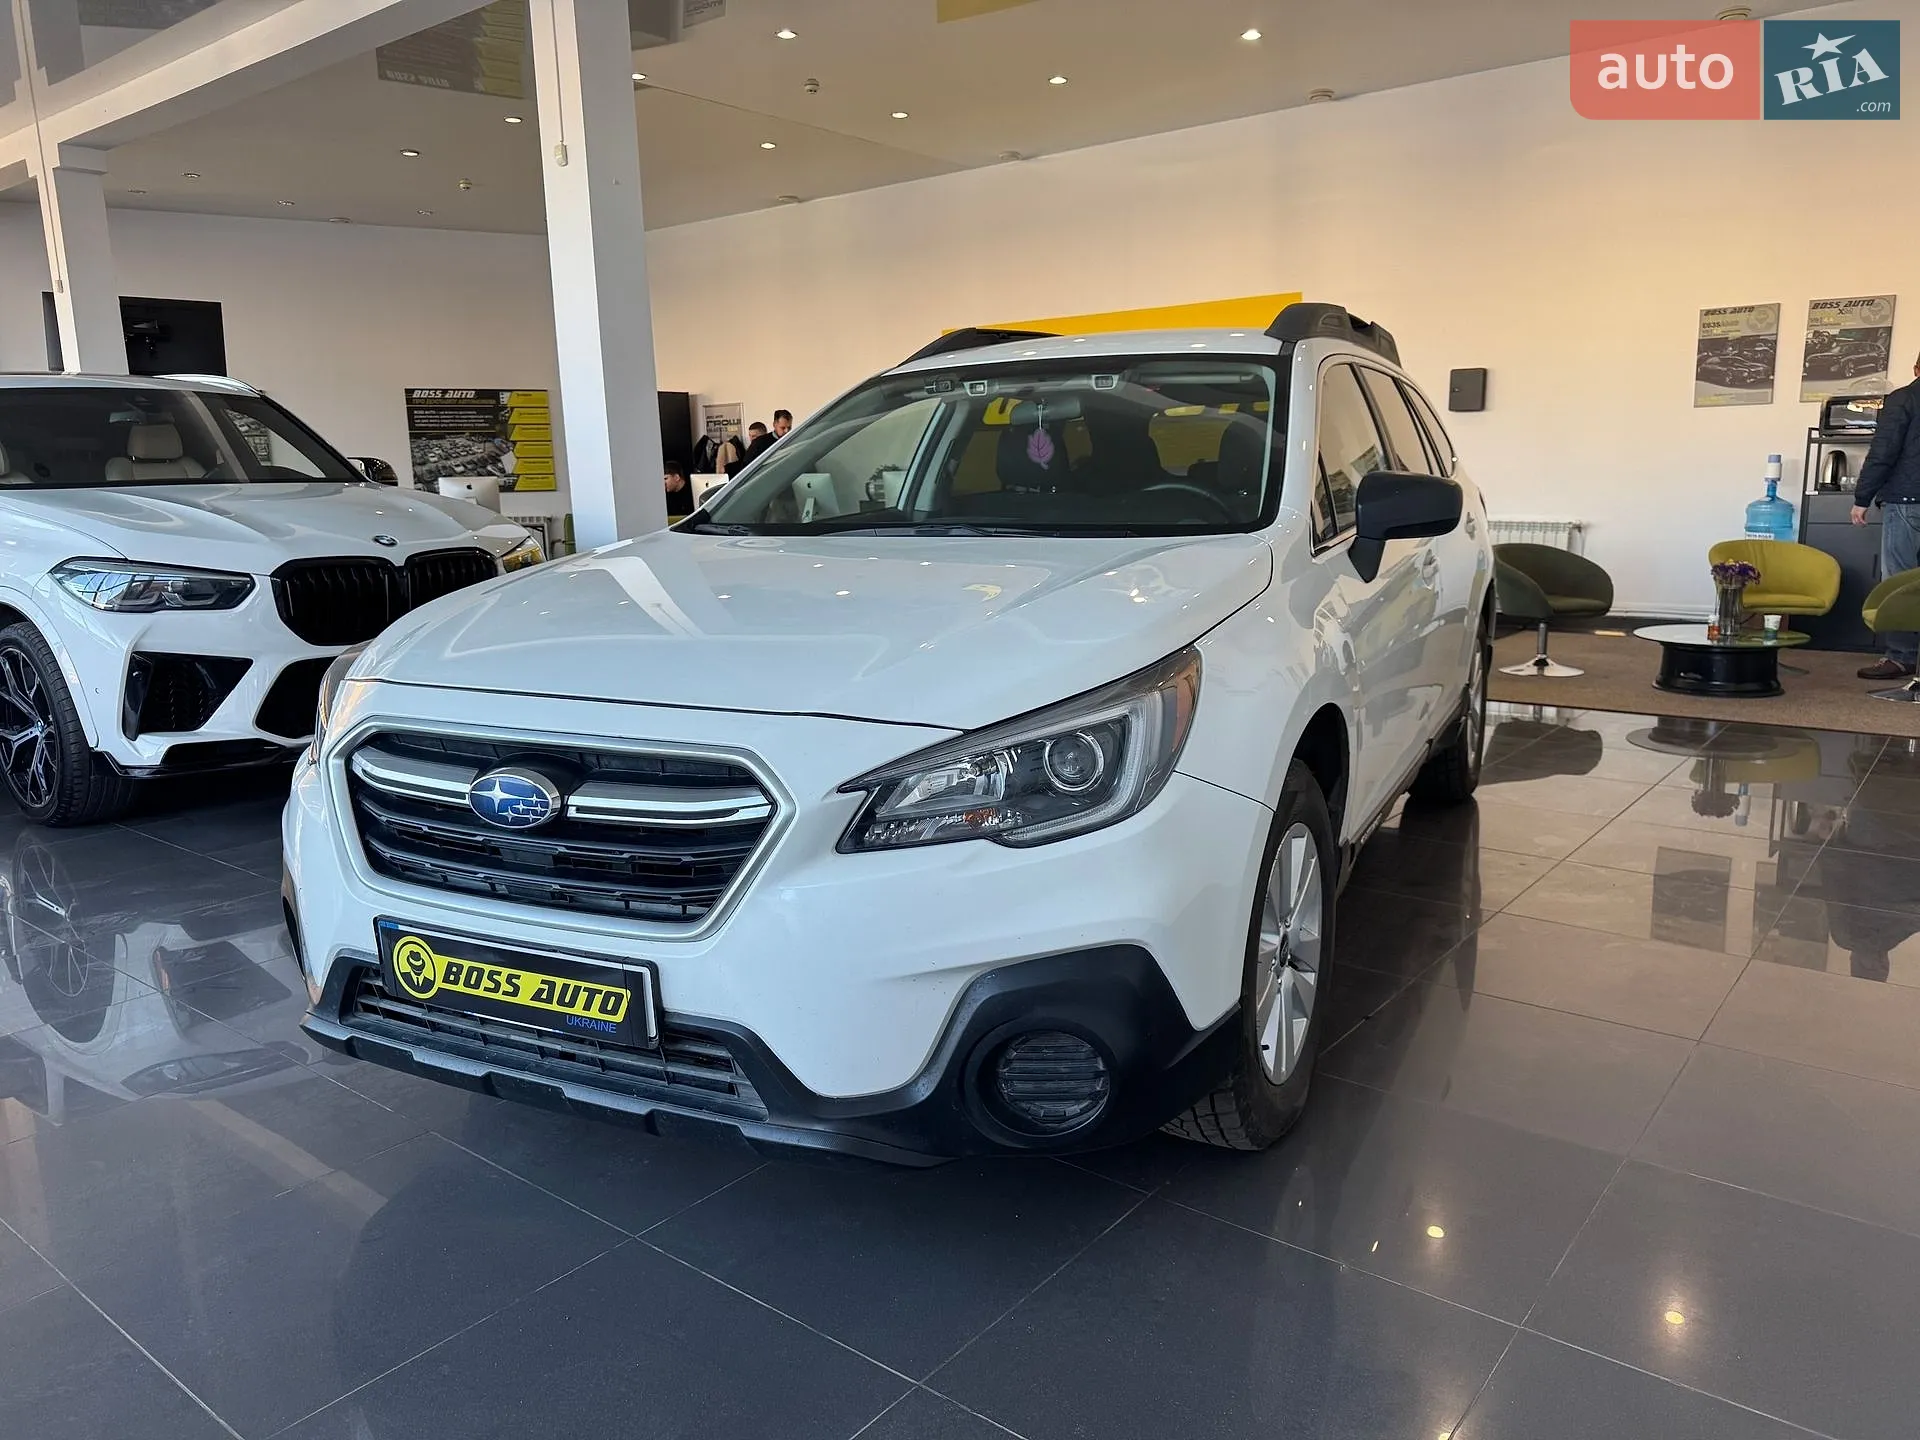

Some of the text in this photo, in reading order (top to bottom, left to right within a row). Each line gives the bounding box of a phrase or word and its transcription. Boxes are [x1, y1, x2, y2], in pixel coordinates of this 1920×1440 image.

[1844, 299, 1874, 307] AUTO
[412, 390, 475, 398] BOSS AUTO
[442, 963, 625, 1016] BOSS AUTO
[566, 1015, 616, 1033] UKRAINE
